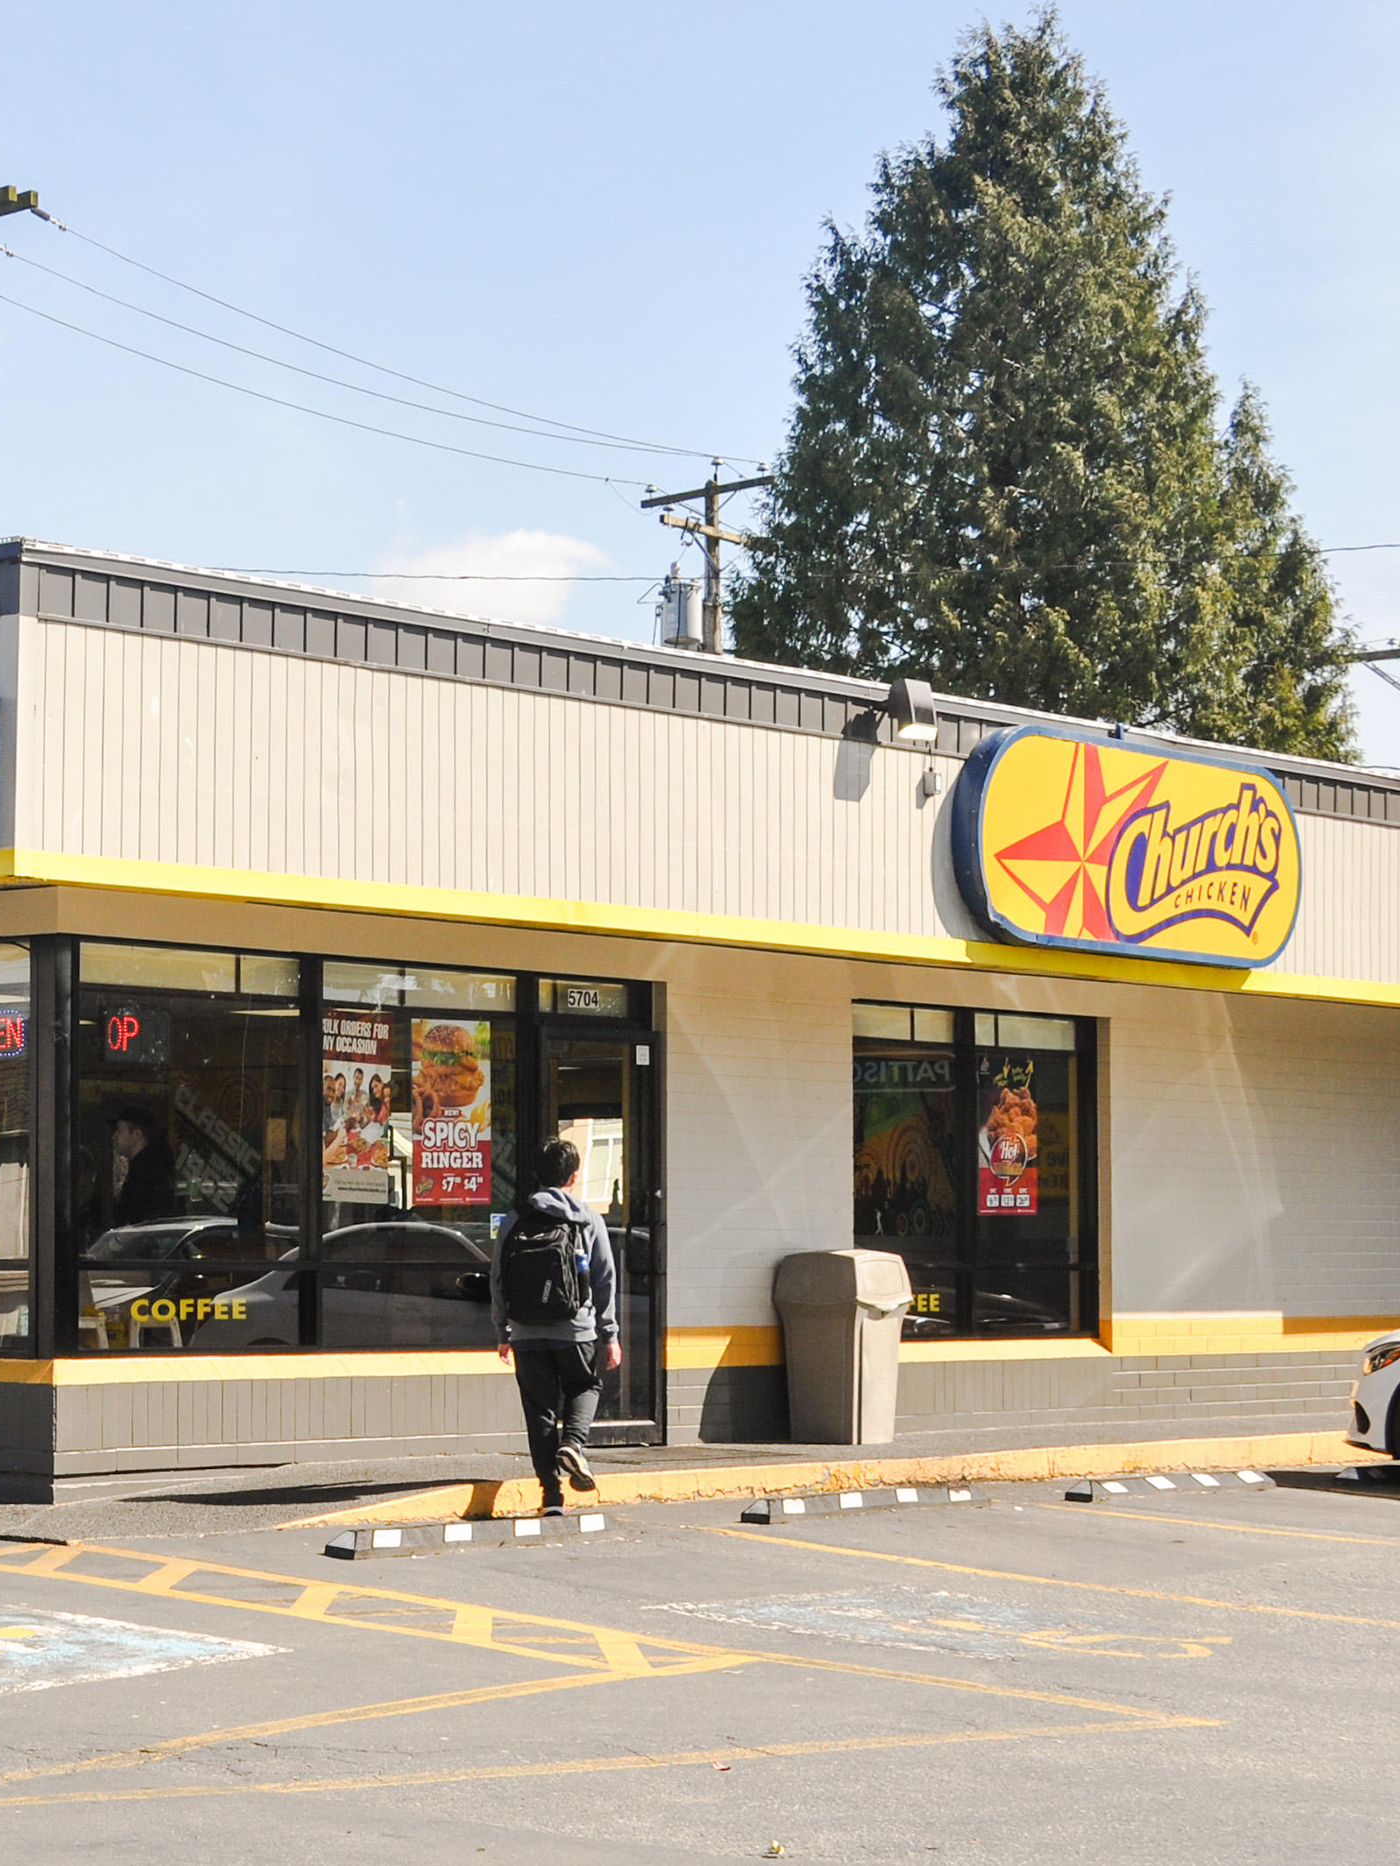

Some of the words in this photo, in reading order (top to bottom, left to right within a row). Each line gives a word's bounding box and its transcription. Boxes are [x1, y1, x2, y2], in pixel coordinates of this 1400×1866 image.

[1111, 789, 1279, 936] Church's
[1174, 880, 1251, 913] CHICKEN
[568, 990, 598, 1007] 5704
[340, 1019, 372, 1037] ORDERS
[373, 1023, 389, 1040] FOR
[335, 1036, 377, 1055] OCCASION
[423, 1121, 480, 1148] SPICY
[421, 1152, 484, 1169] RINGER
[131, 1298, 247, 1322] COFFEE
